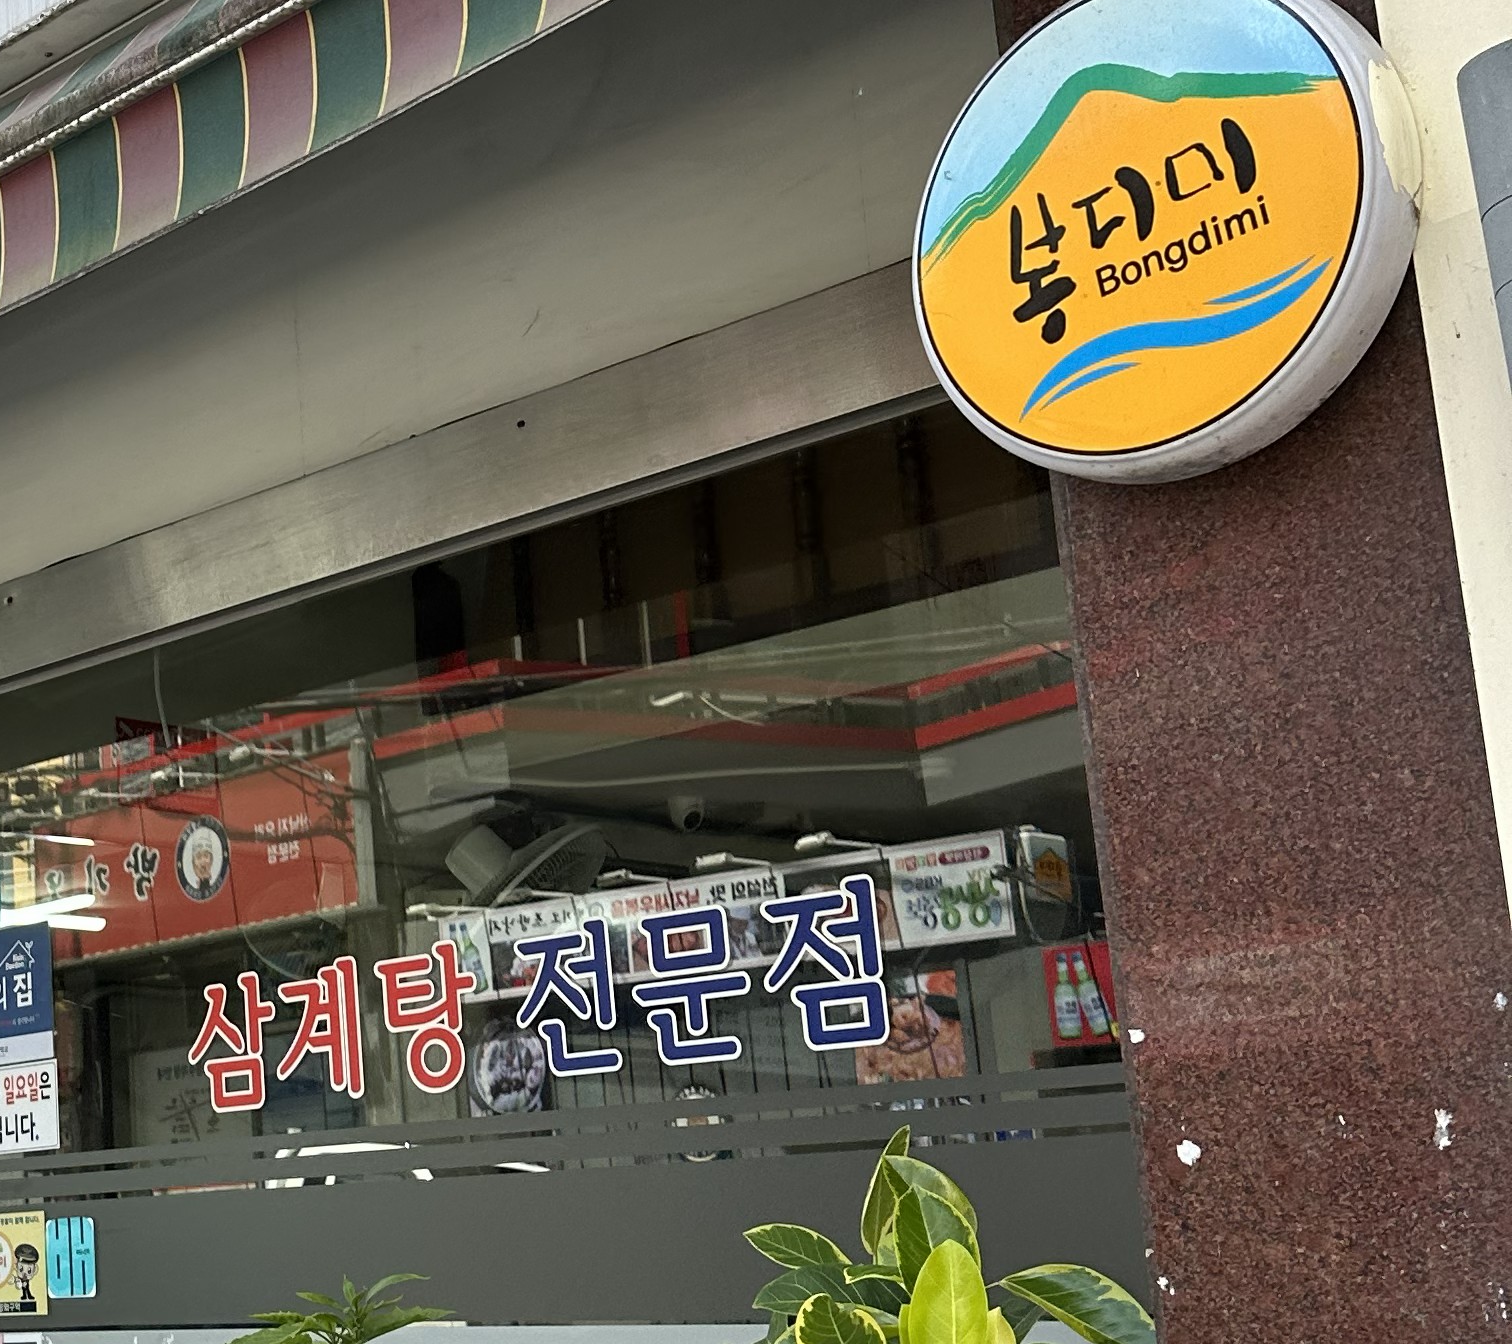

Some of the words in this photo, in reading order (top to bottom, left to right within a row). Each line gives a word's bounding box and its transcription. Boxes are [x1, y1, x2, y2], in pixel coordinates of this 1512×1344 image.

[1009, 118, 1257, 344] 봉디미
[1094, 195, 1271, 297] Bongdimi
[13, 971, 33, 1008] 집
[188, 940, 476, 1113] 삼계탕
[513, 873, 891, 1079] 전문점
[3, 1071, 51, 1105] 일요일은
